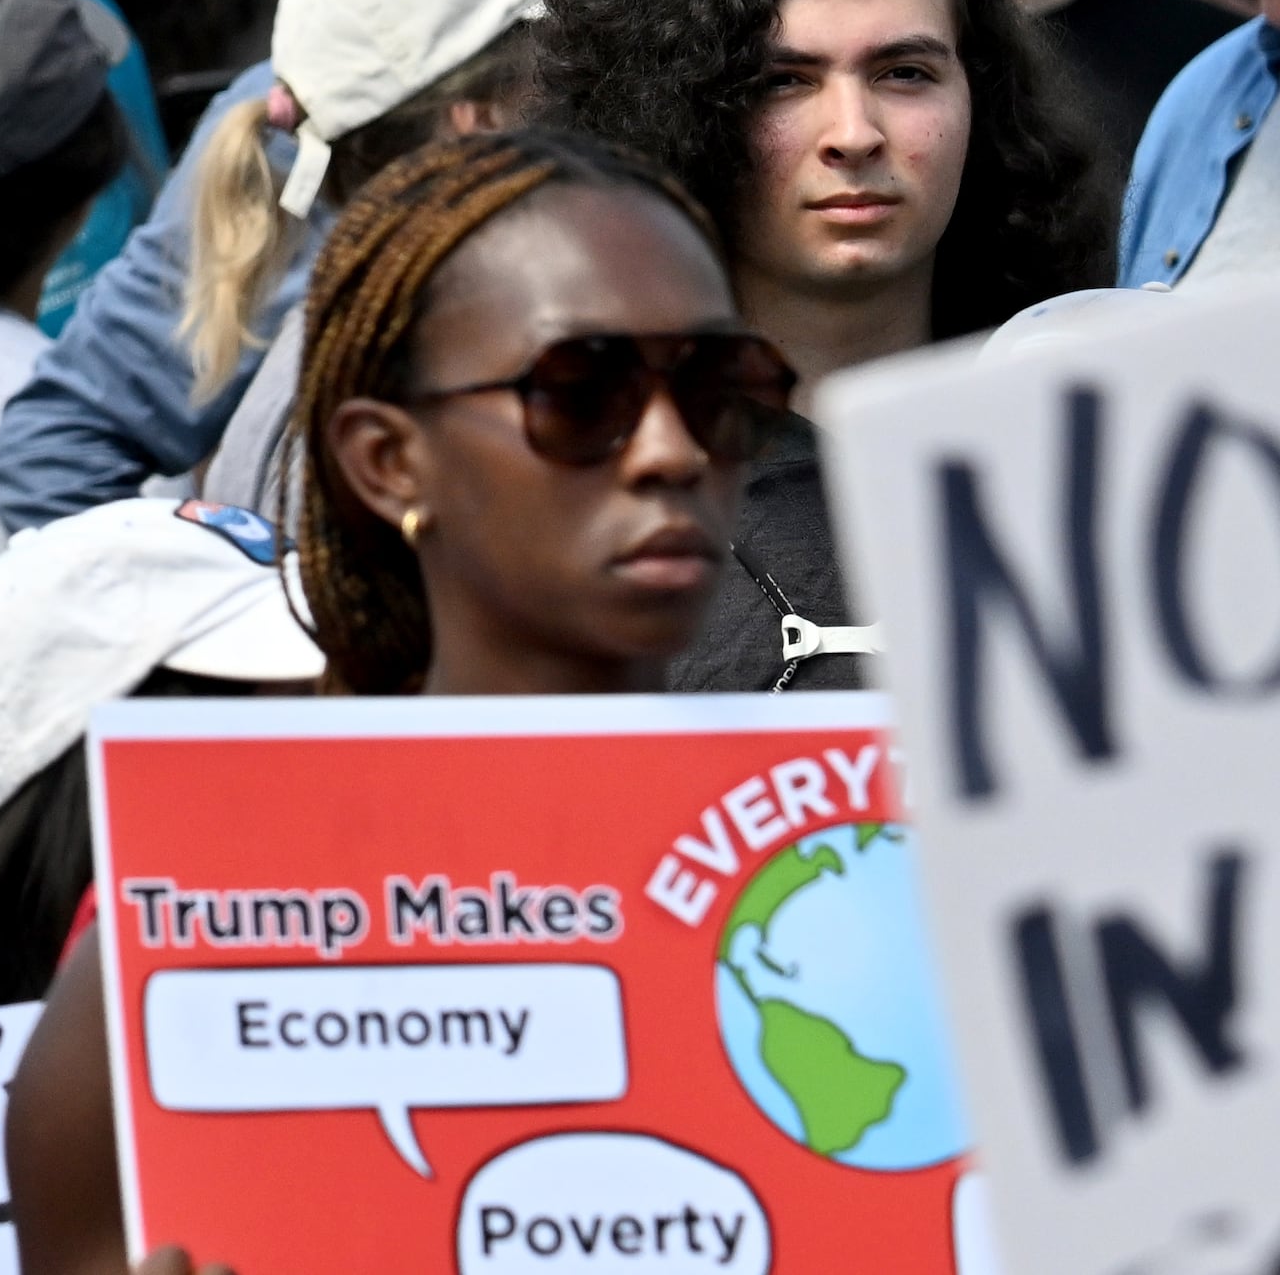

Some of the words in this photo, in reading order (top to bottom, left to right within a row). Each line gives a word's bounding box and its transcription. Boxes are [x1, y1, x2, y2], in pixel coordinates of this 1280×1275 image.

[932, 379, 1280, 804] NO
[644, 742, 884, 930] EVERY
[126, 882, 366, 954] Trump
[387, 877, 622, 946] Makes
[235, 1000, 532, 1056] Economy
[1010, 844, 1258, 1169] IN
[478, 1202, 748, 1266] Poverty
